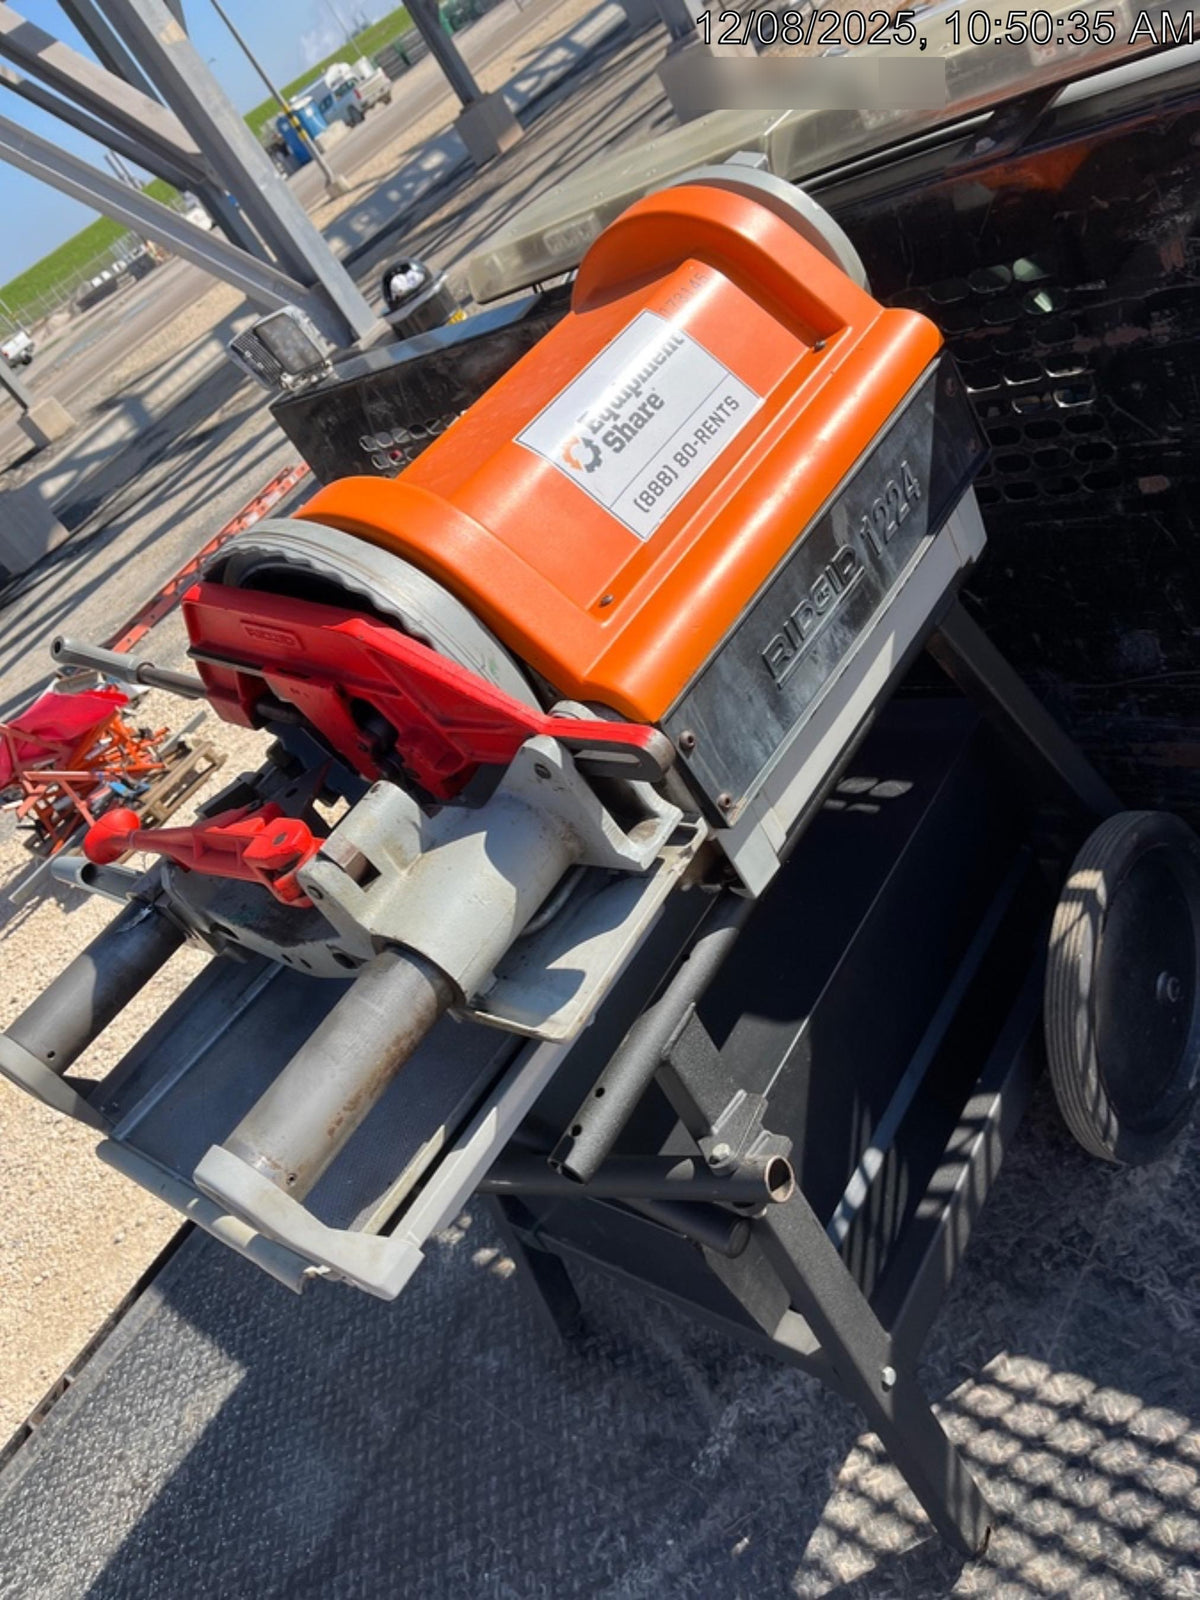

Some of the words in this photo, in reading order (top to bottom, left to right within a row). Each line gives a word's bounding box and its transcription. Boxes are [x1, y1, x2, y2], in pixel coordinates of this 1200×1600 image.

[602, 392, 665, 453] Share
[633, 464, 679, 513] (888)
[673, 395, 740, 468] 80-RENTS
[762, 544, 860, 681] RIDGID
[860, 460, 921, 557] 1224
